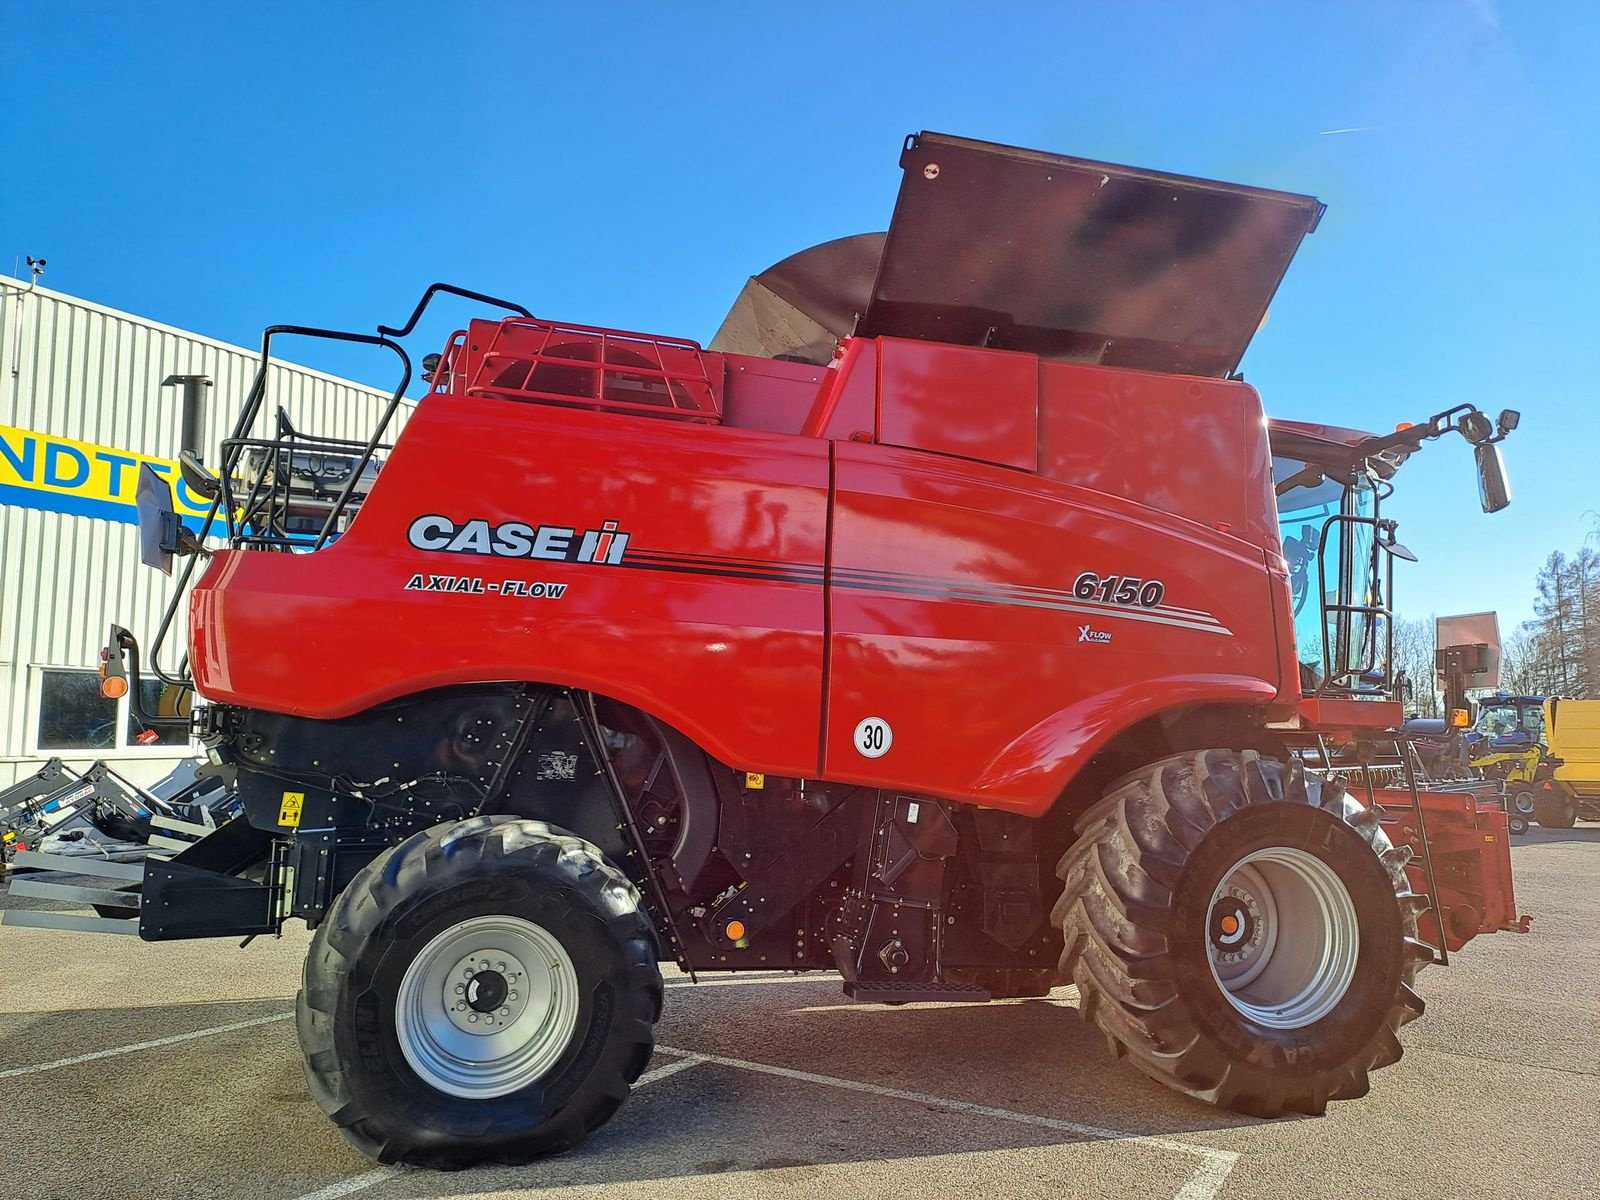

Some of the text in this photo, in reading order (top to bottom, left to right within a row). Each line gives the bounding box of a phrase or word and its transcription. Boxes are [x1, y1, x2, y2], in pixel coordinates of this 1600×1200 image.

[408, 514, 575, 560] CASE
[1072, 570, 1166, 609] 6150
[1089, 631, 1112, 640] FLOW
[863, 725, 883, 750] 30
